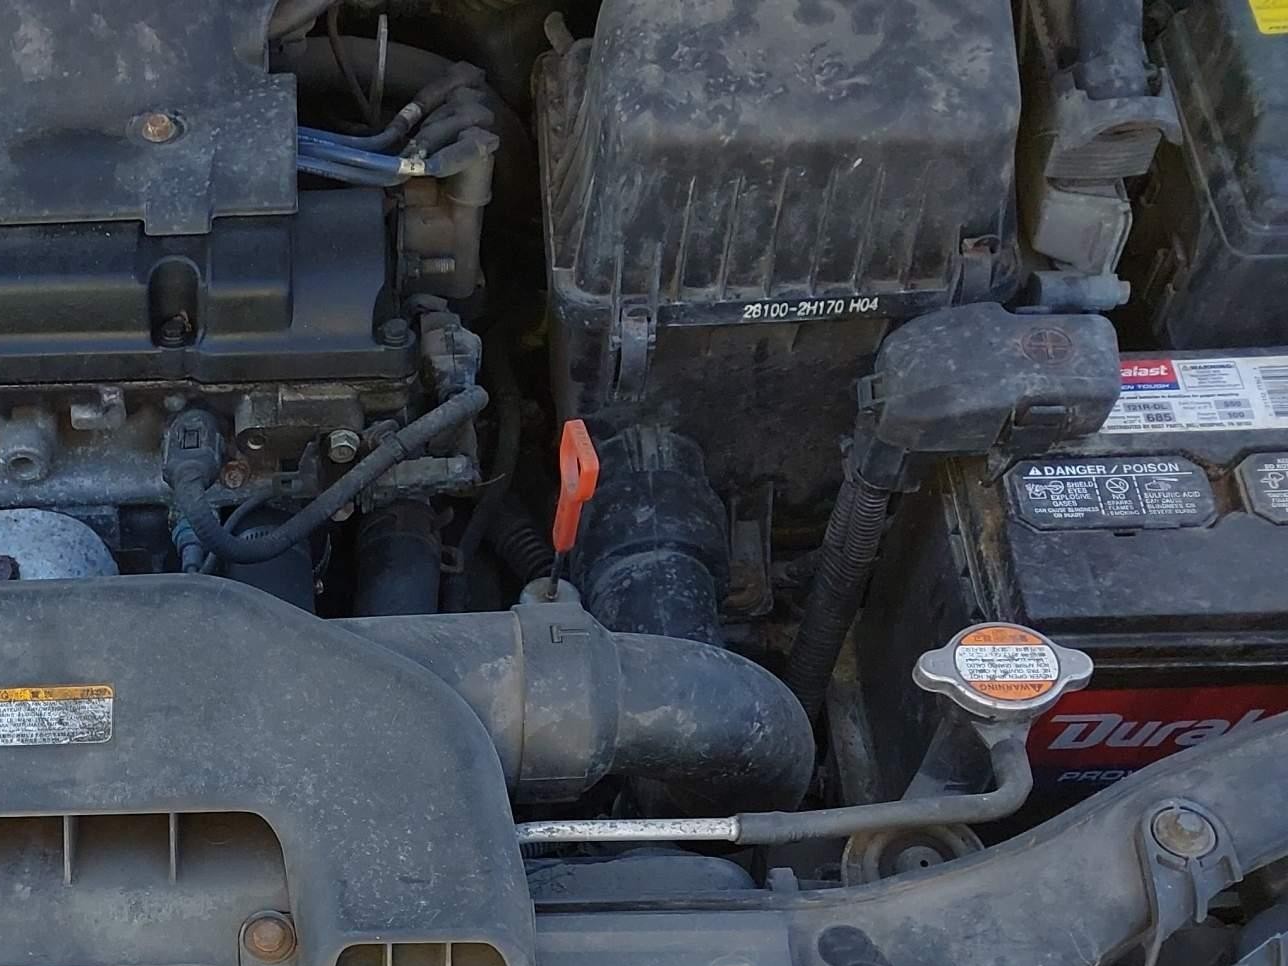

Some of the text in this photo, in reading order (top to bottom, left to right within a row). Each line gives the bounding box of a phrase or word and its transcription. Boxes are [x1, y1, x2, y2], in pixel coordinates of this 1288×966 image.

[742, 296, 879, 319] 28100-2H170 H04
[1120, 364, 1169, 377] alast
[1044, 464, 1106, 475] DANGER
[1123, 463, 1180, 473] POISON
[1051, 493, 1092, 501] EXPLOSIVE
[979, 683, 1031, 692] WARNING
[1057, 770, 1128, 782] PRO
